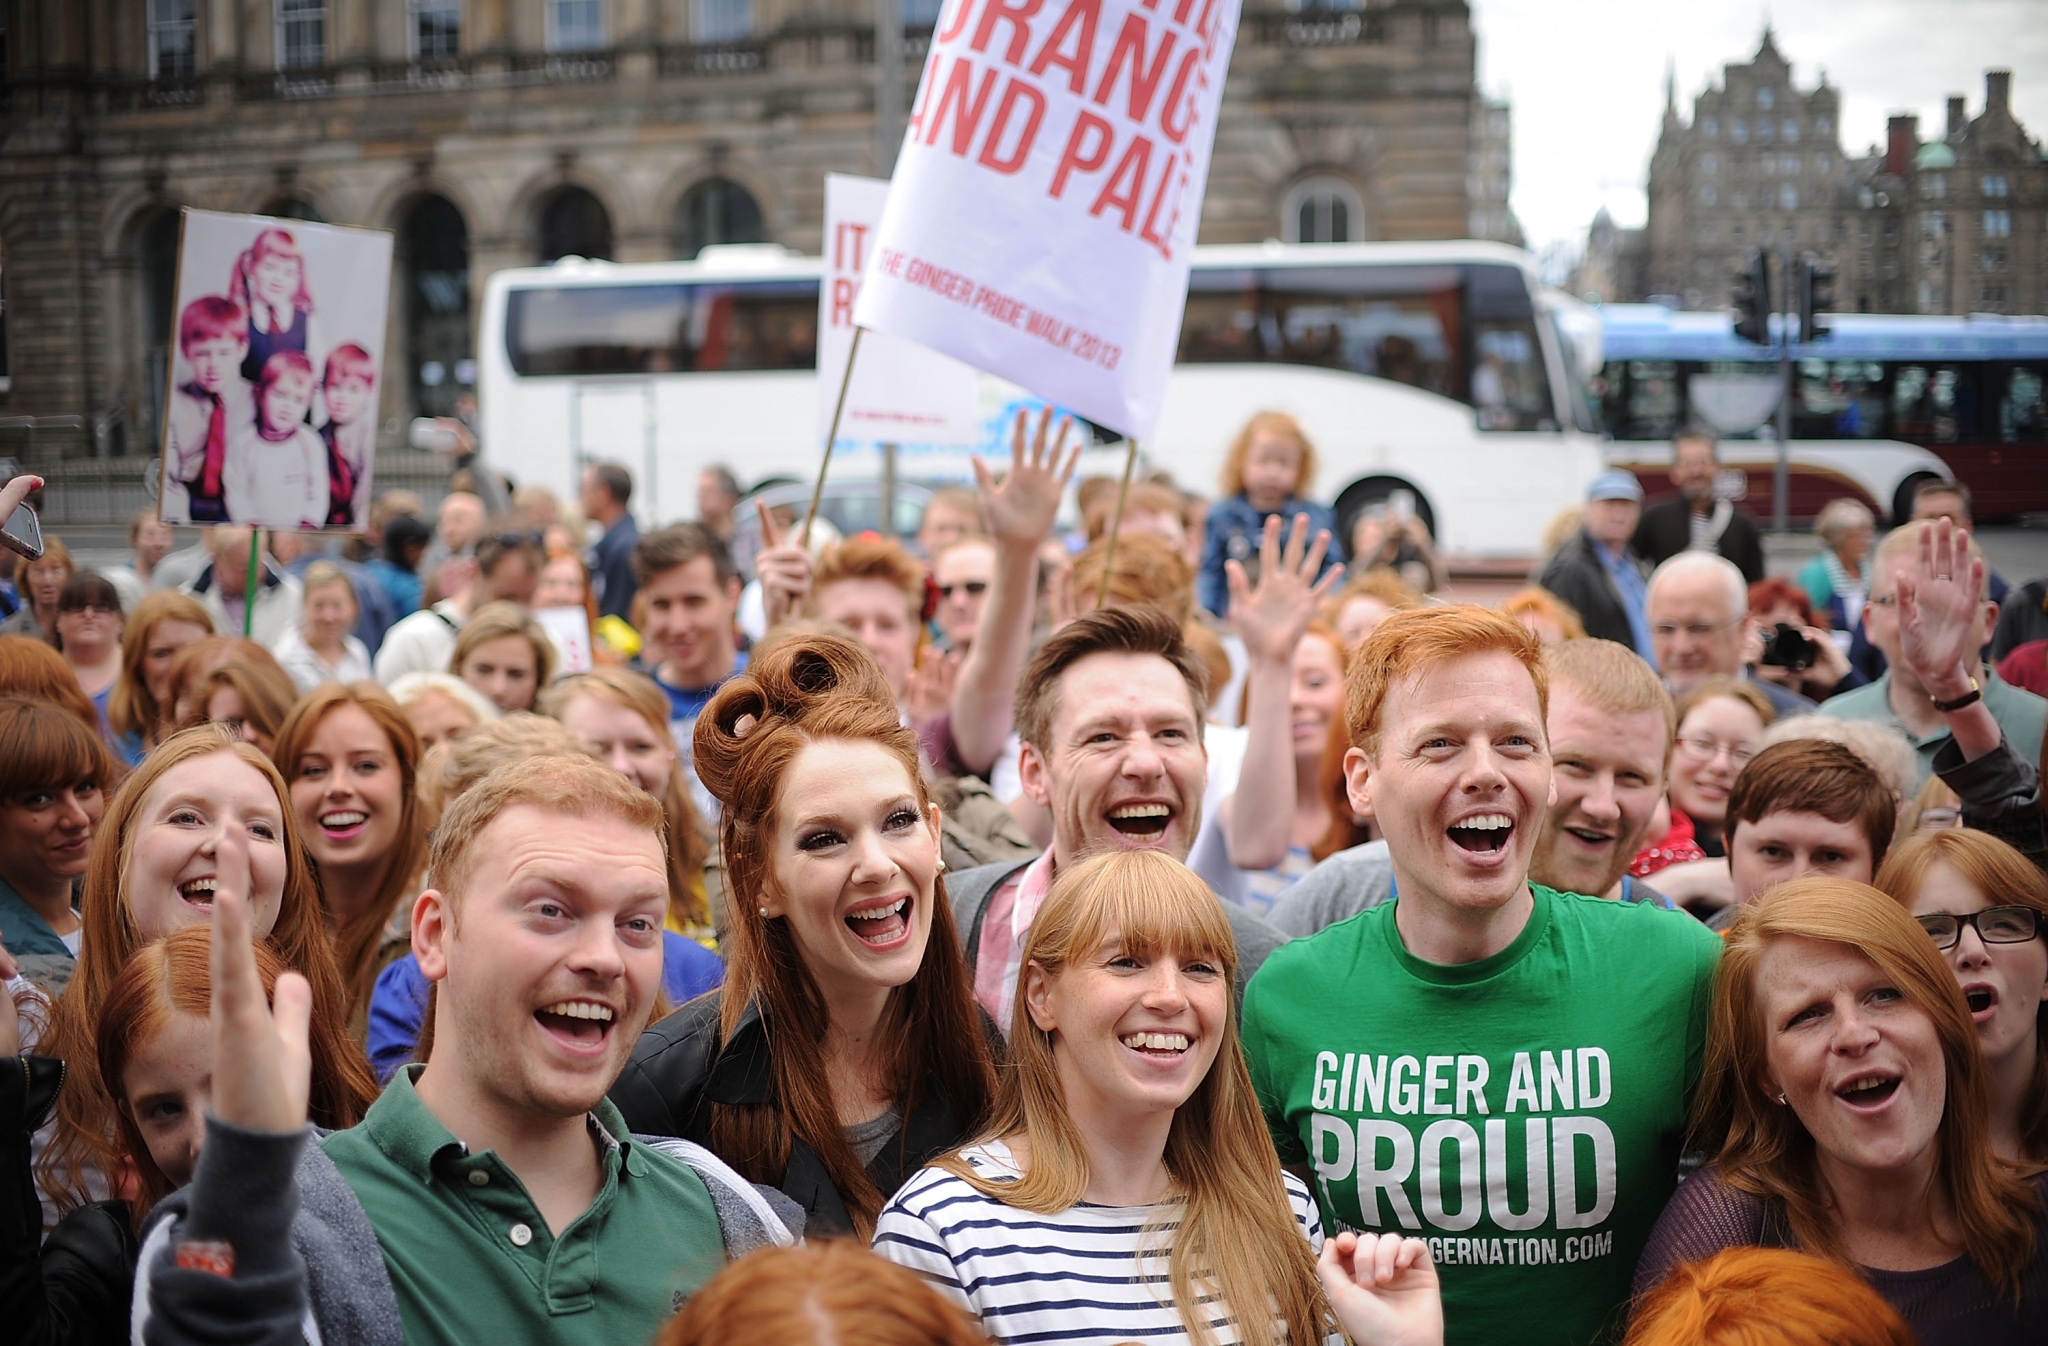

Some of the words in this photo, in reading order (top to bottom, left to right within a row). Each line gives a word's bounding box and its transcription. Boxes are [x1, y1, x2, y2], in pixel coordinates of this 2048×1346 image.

[937, 0, 1207, 143] RANG
[1048, 109, 1187, 261] PAL
[880, 247, 905, 279] THE
[904, 257, 975, 309] GINGER
[972, 283, 1025, 330] PRIDE
[1024, 308, 1079, 351] WALK
[1072, 331, 1123, 372] 2013
[1311, 1051, 1490, 1114] GINGER
[1504, 1046, 1612, 1113] AND
[1310, 1111, 1617, 1231] PROUD
[1333, 1217, 1613, 1266] GERNATION.COM
